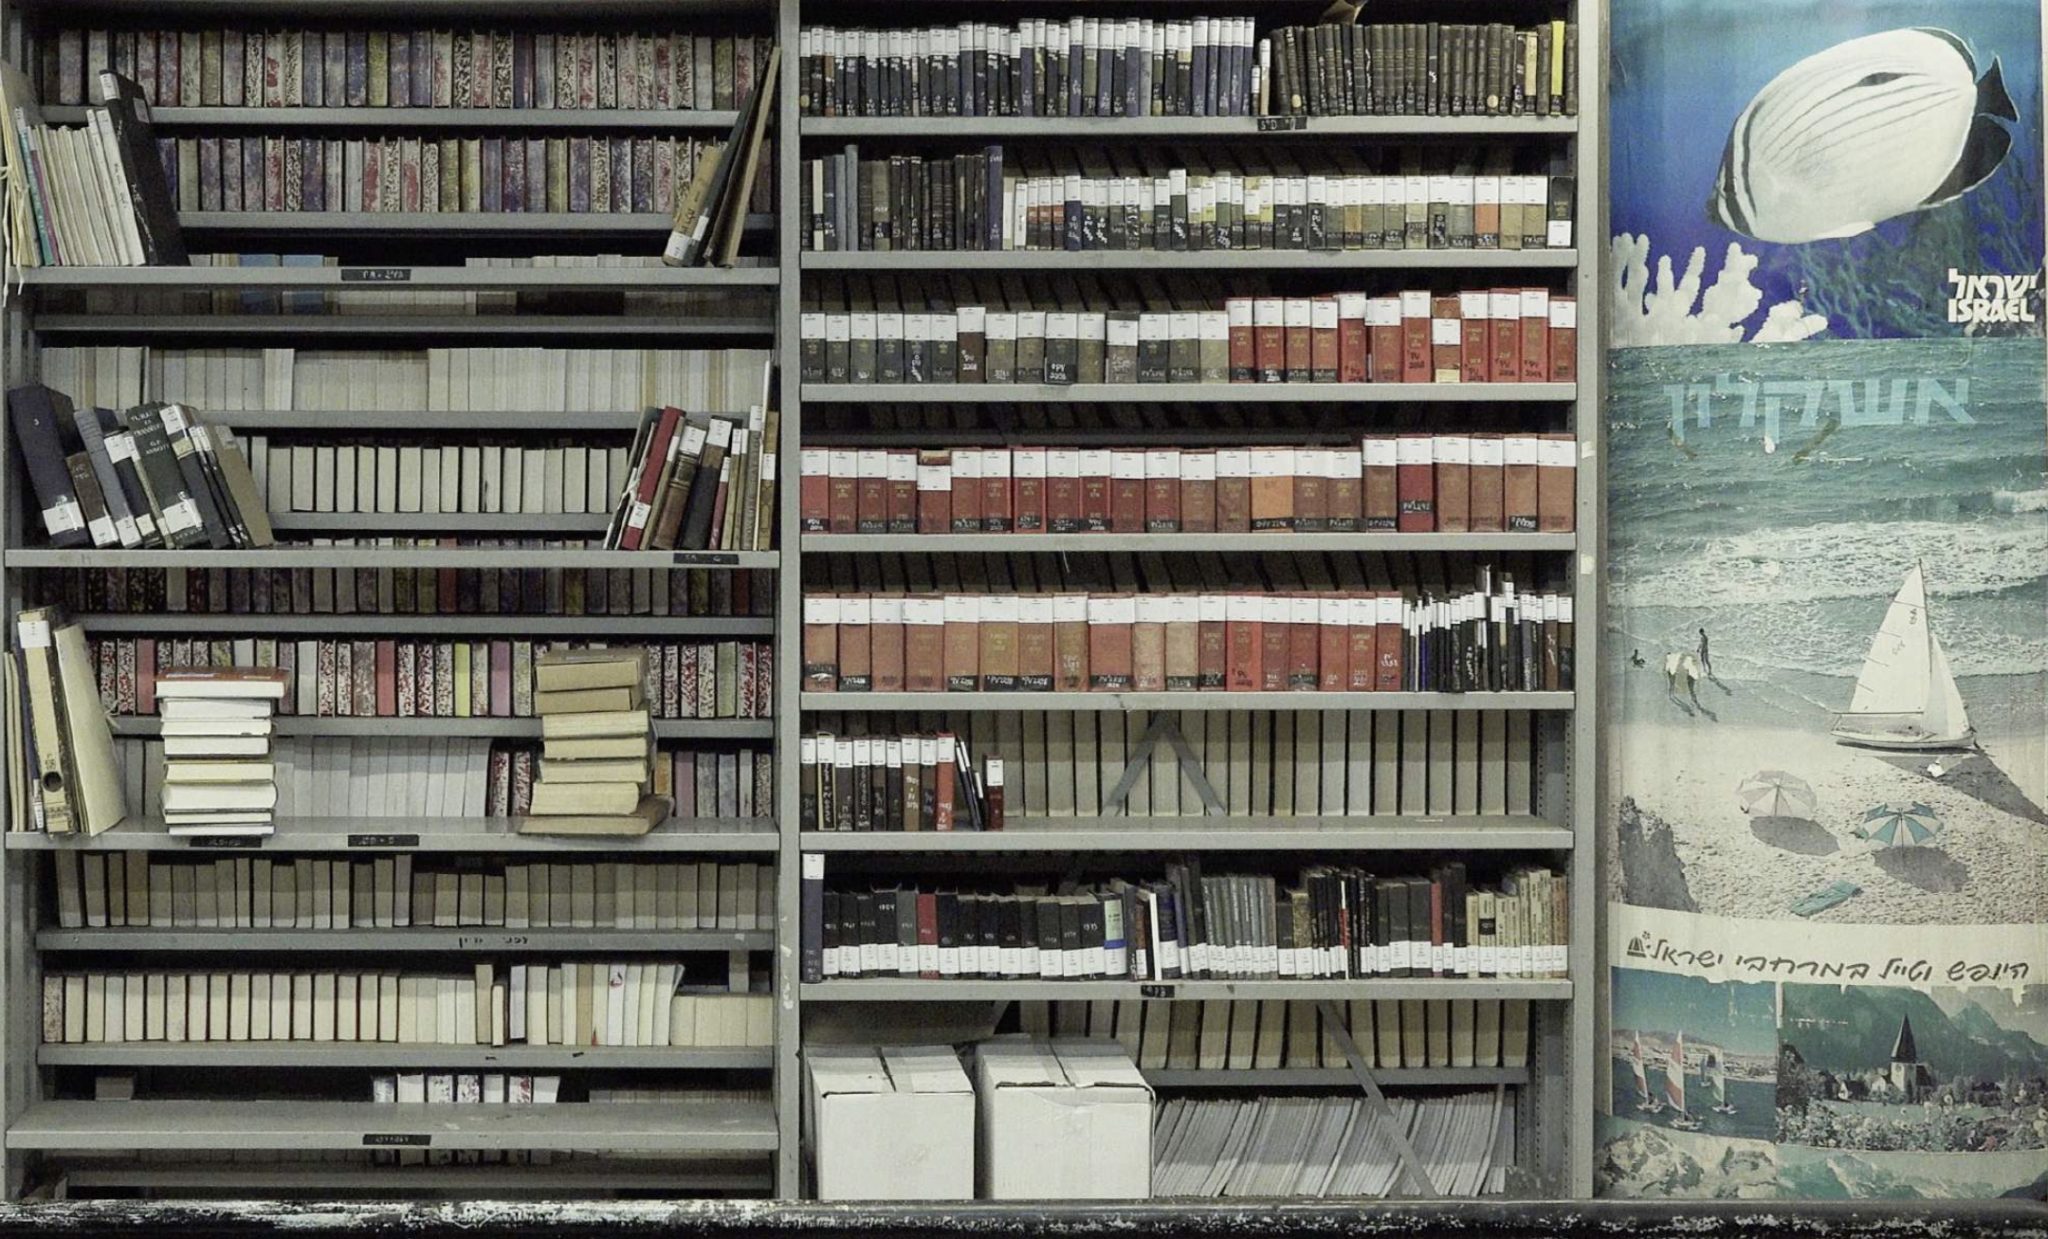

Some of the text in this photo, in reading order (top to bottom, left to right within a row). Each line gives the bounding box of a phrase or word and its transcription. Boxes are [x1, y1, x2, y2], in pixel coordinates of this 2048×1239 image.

[1948, 268, 2037, 300] ישראל
[1948, 299, 2036, 324] ISRAEL
[1663, 372, 1977, 444] אשקלון
[1649, 938, 1724, 968] ישראל
